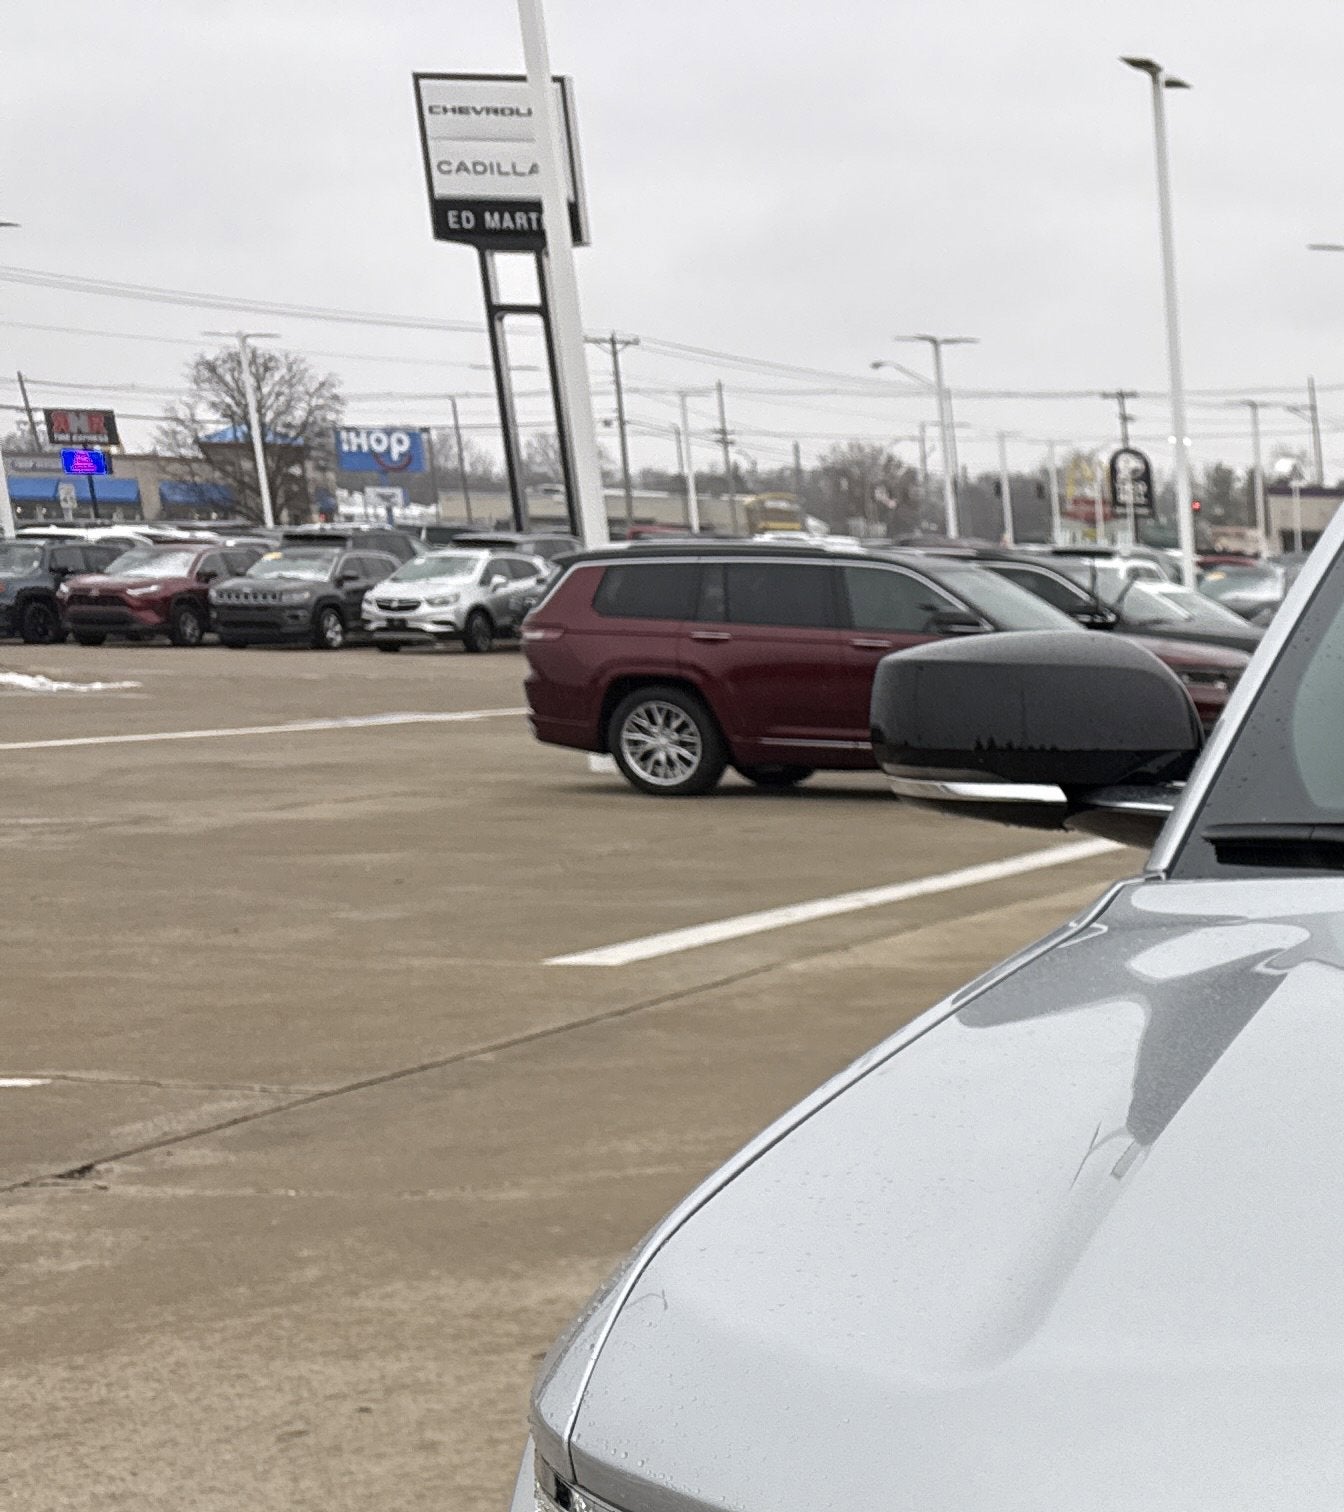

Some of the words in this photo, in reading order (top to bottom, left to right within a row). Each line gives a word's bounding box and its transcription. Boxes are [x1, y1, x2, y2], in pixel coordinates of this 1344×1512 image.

[428, 104, 533, 118] CHEVROL
[436, 159, 540, 177] CADILLA
[447, 210, 475, 229] ED
[484, 211, 544, 231] MART
